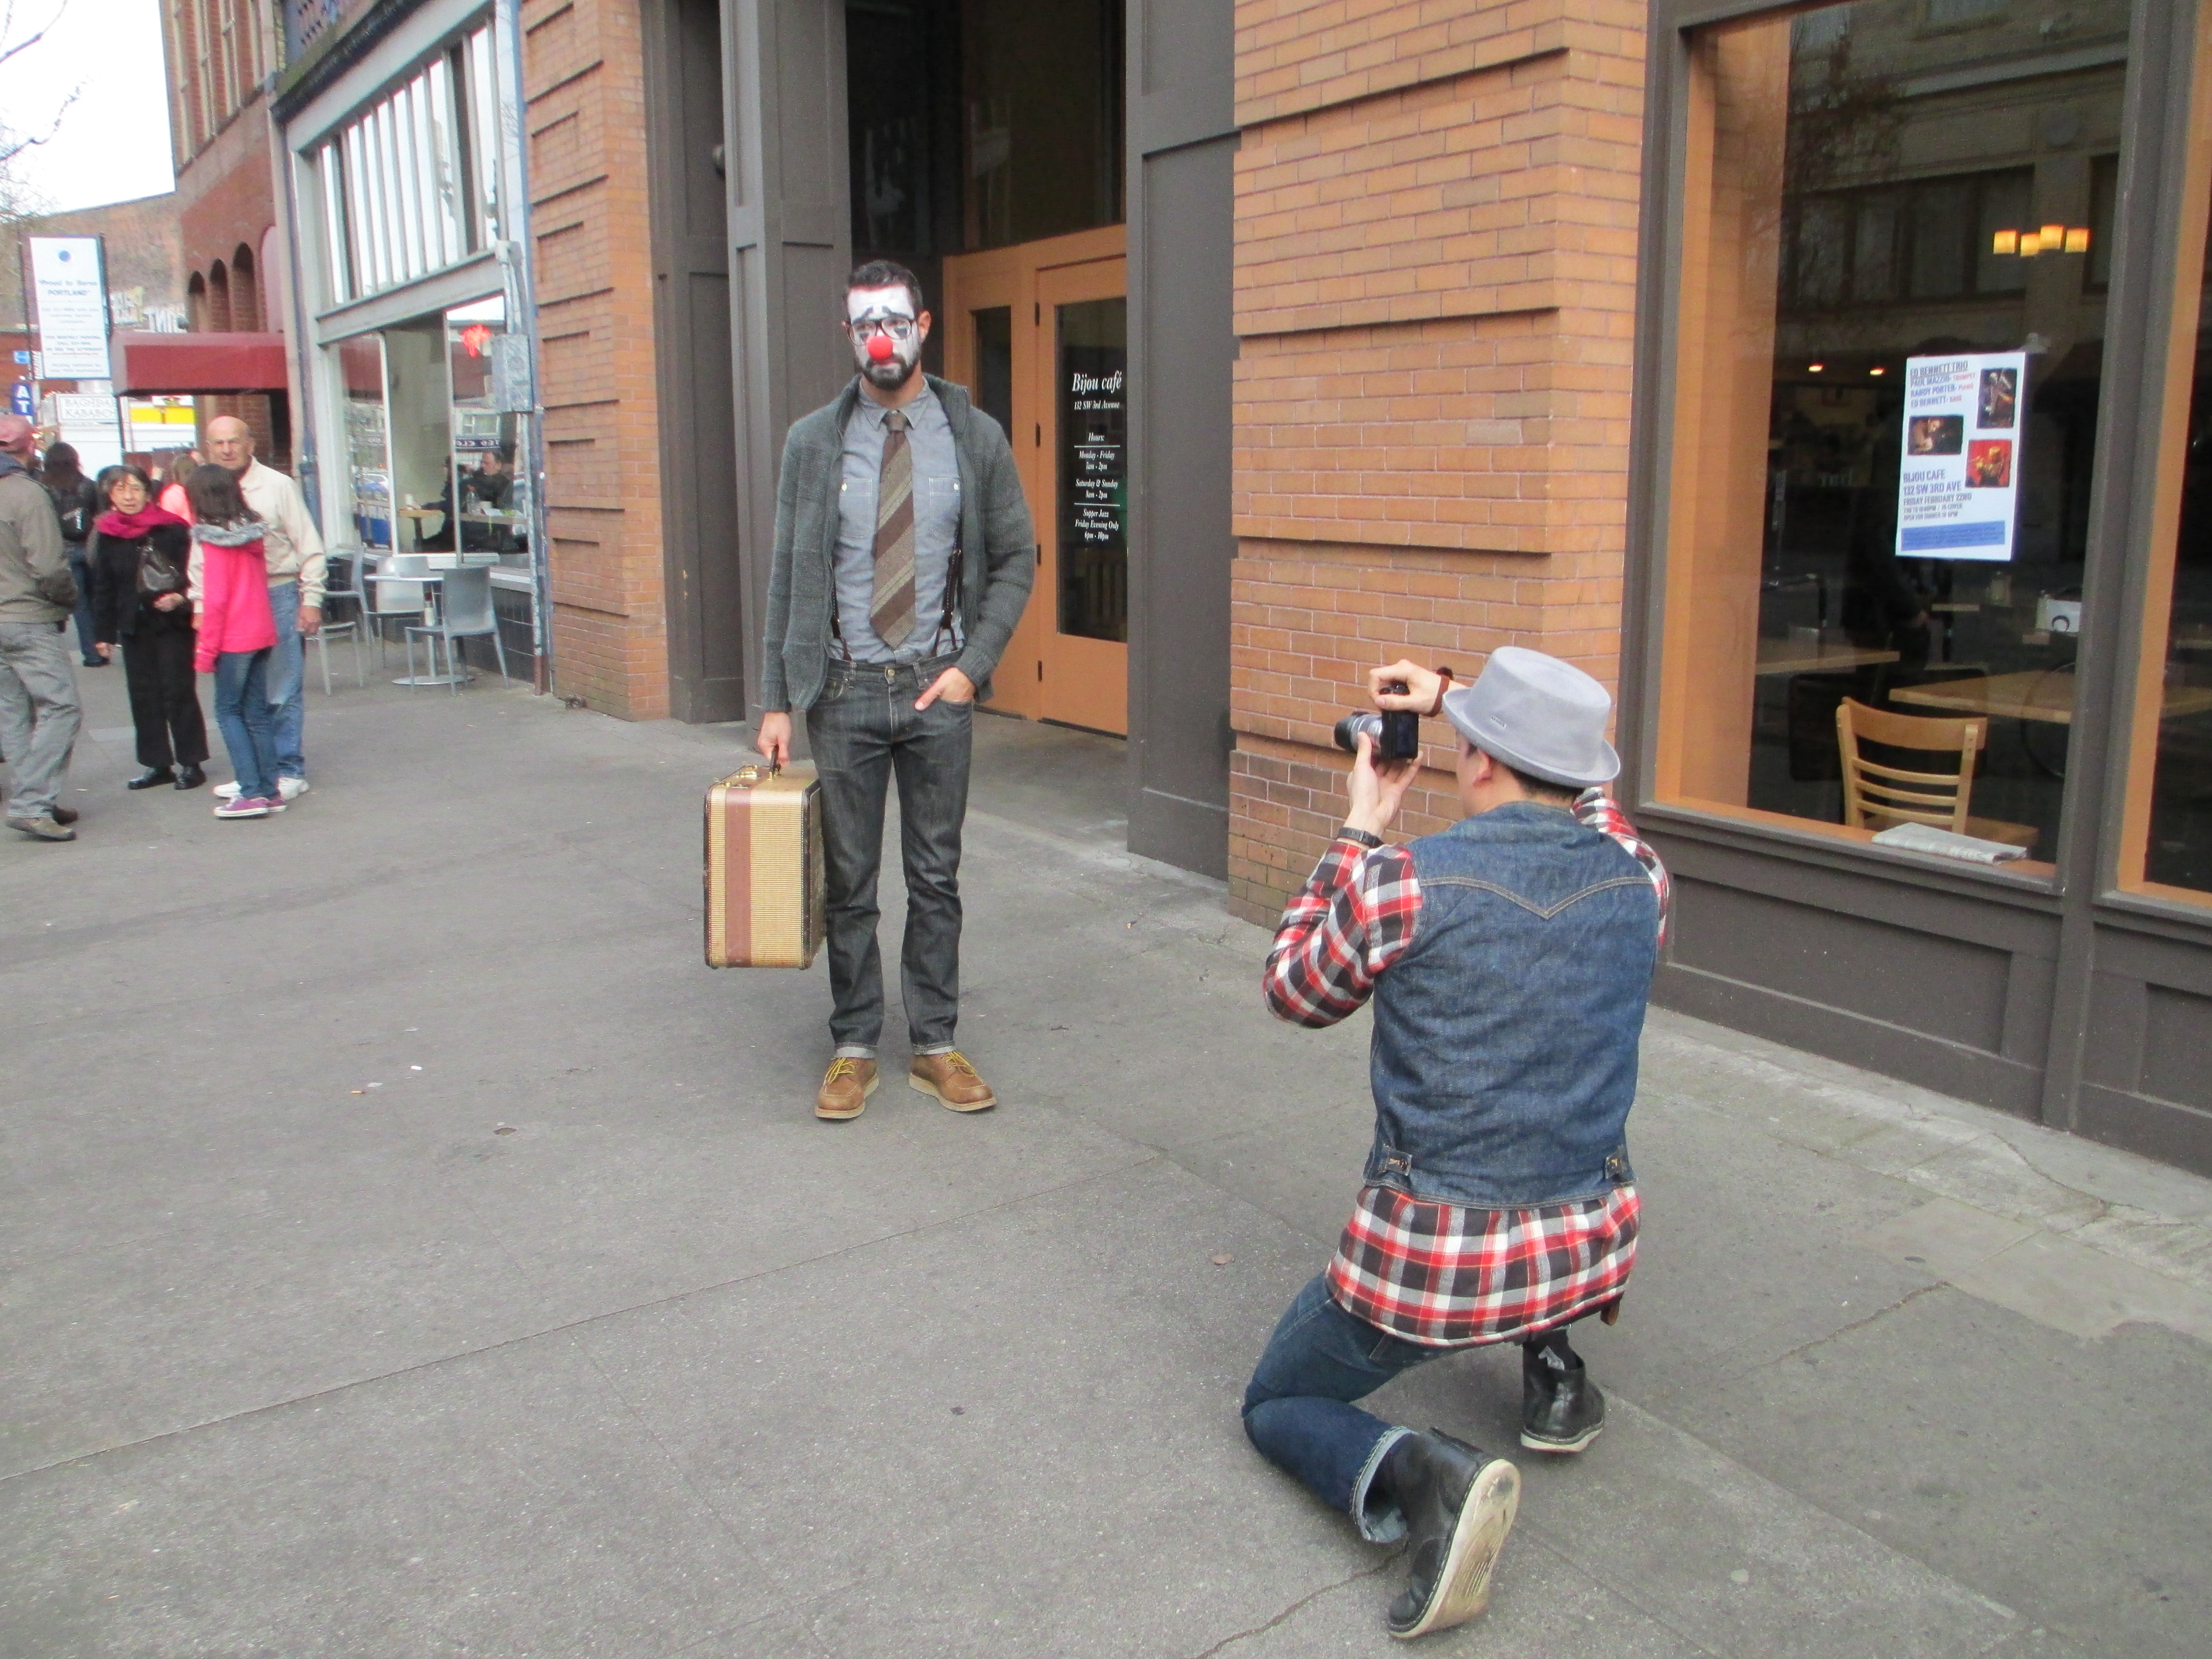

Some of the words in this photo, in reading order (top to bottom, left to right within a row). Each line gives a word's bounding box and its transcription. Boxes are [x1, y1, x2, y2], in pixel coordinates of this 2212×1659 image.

[1910, 367, 1919, 377] ED
[1920, 363, 1950, 376] BENNETT
[1951, 360, 1968, 373] TRIO
[1071, 373, 1099, 395] Bijou
[1101, 370, 1122, 394] café
[1074, 400, 1082, 410] 132
[1083, 400, 1093, 410] SW
[1093, 399, 1101, 410] 3rd
[1102, 399, 1120, 409] Avenue
[1088, 432, 1105, 442] Hours:
[1079, 450, 1096, 460] Monday
[1100, 450, 1115, 460] Friday
[1098, 461, 1107, 471] 2pm
[1903, 471, 1925, 483] BIJOU
[1926, 468, 1946, 481] CAFE
[1075, 479, 1095, 489] Saturday
[1096, 479, 1101, 487] &
[1101, 479, 1118, 489] Sunday
[1904, 485, 1915, 496] 132
[1916, 483, 1928, 495] SW
[1930, 481, 1945, 494] 3RD
[1946, 480, 1962, 492] AVE
[1085, 490, 1094, 498] 8am
[1098, 490, 1108, 500] 2pm
[1904, 496, 1923, 506] FRIDAY
[1924, 493, 1954, 504] FEBRUARY
[1083, 508, 1098, 518] Supper
[1098, 509, 1109, 517] Jazz
[1075, 519, 1090, 529] Friday
[1090, 519, 1107, 530] Evening
[1108, 520, 1119, 531] Only
[1084, 530, 1094, 541] 6pm
[1097, 531, 1109, 541] 10pm
